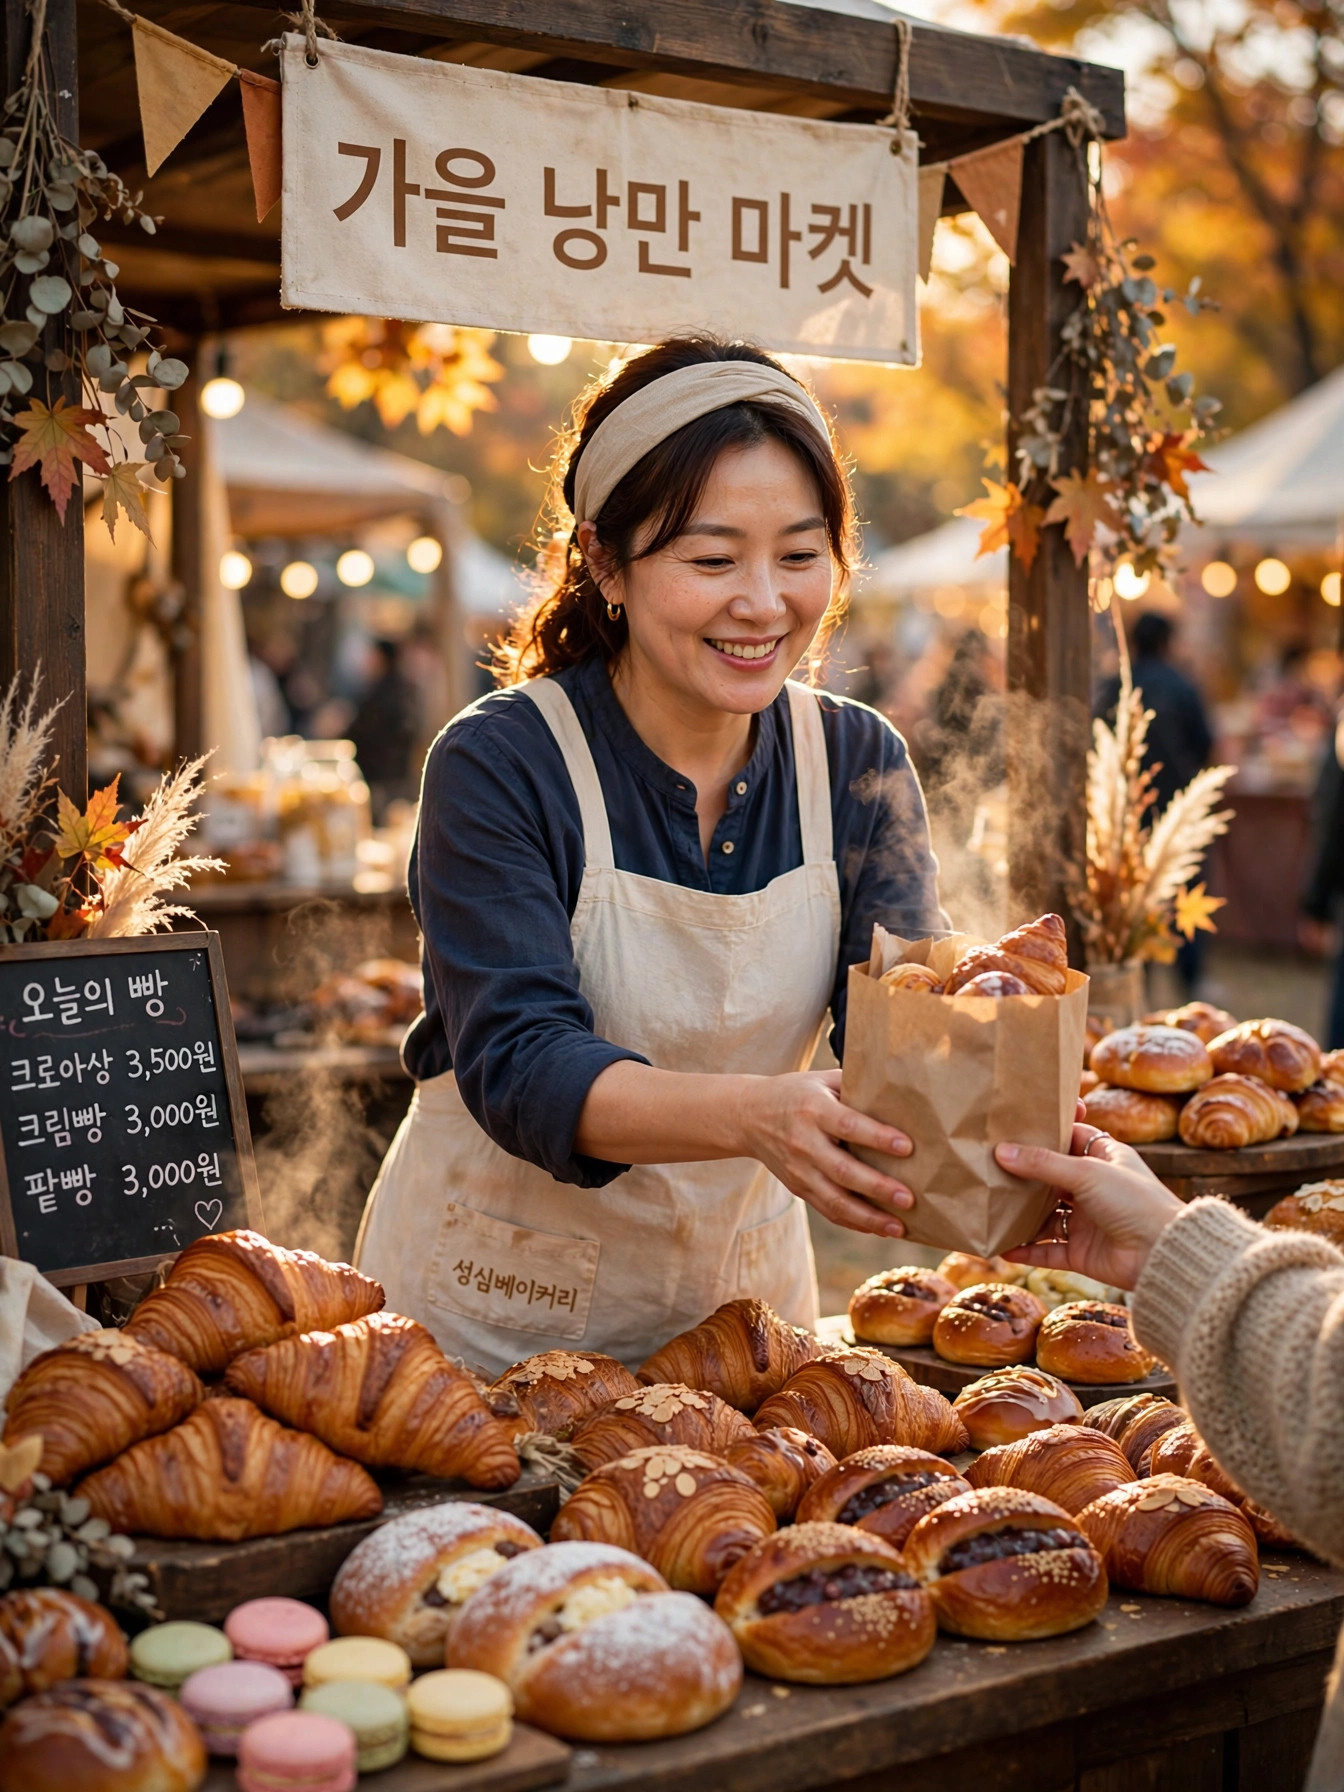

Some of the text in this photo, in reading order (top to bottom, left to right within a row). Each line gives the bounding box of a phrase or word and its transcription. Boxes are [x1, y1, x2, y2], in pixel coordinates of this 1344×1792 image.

[332, 138, 873, 299] 가을 낭만 마켓
[22, 969, 169, 1026] 오늘의 빵
[10, 1041, 217, 1091] 크로아상 3,500원
[18, 1094, 219, 1148] 크림빵 3,000원
[23, 1152, 223, 1214] 팥빵 3,000원
[452, 1259, 578, 1313] 성심베이커리
